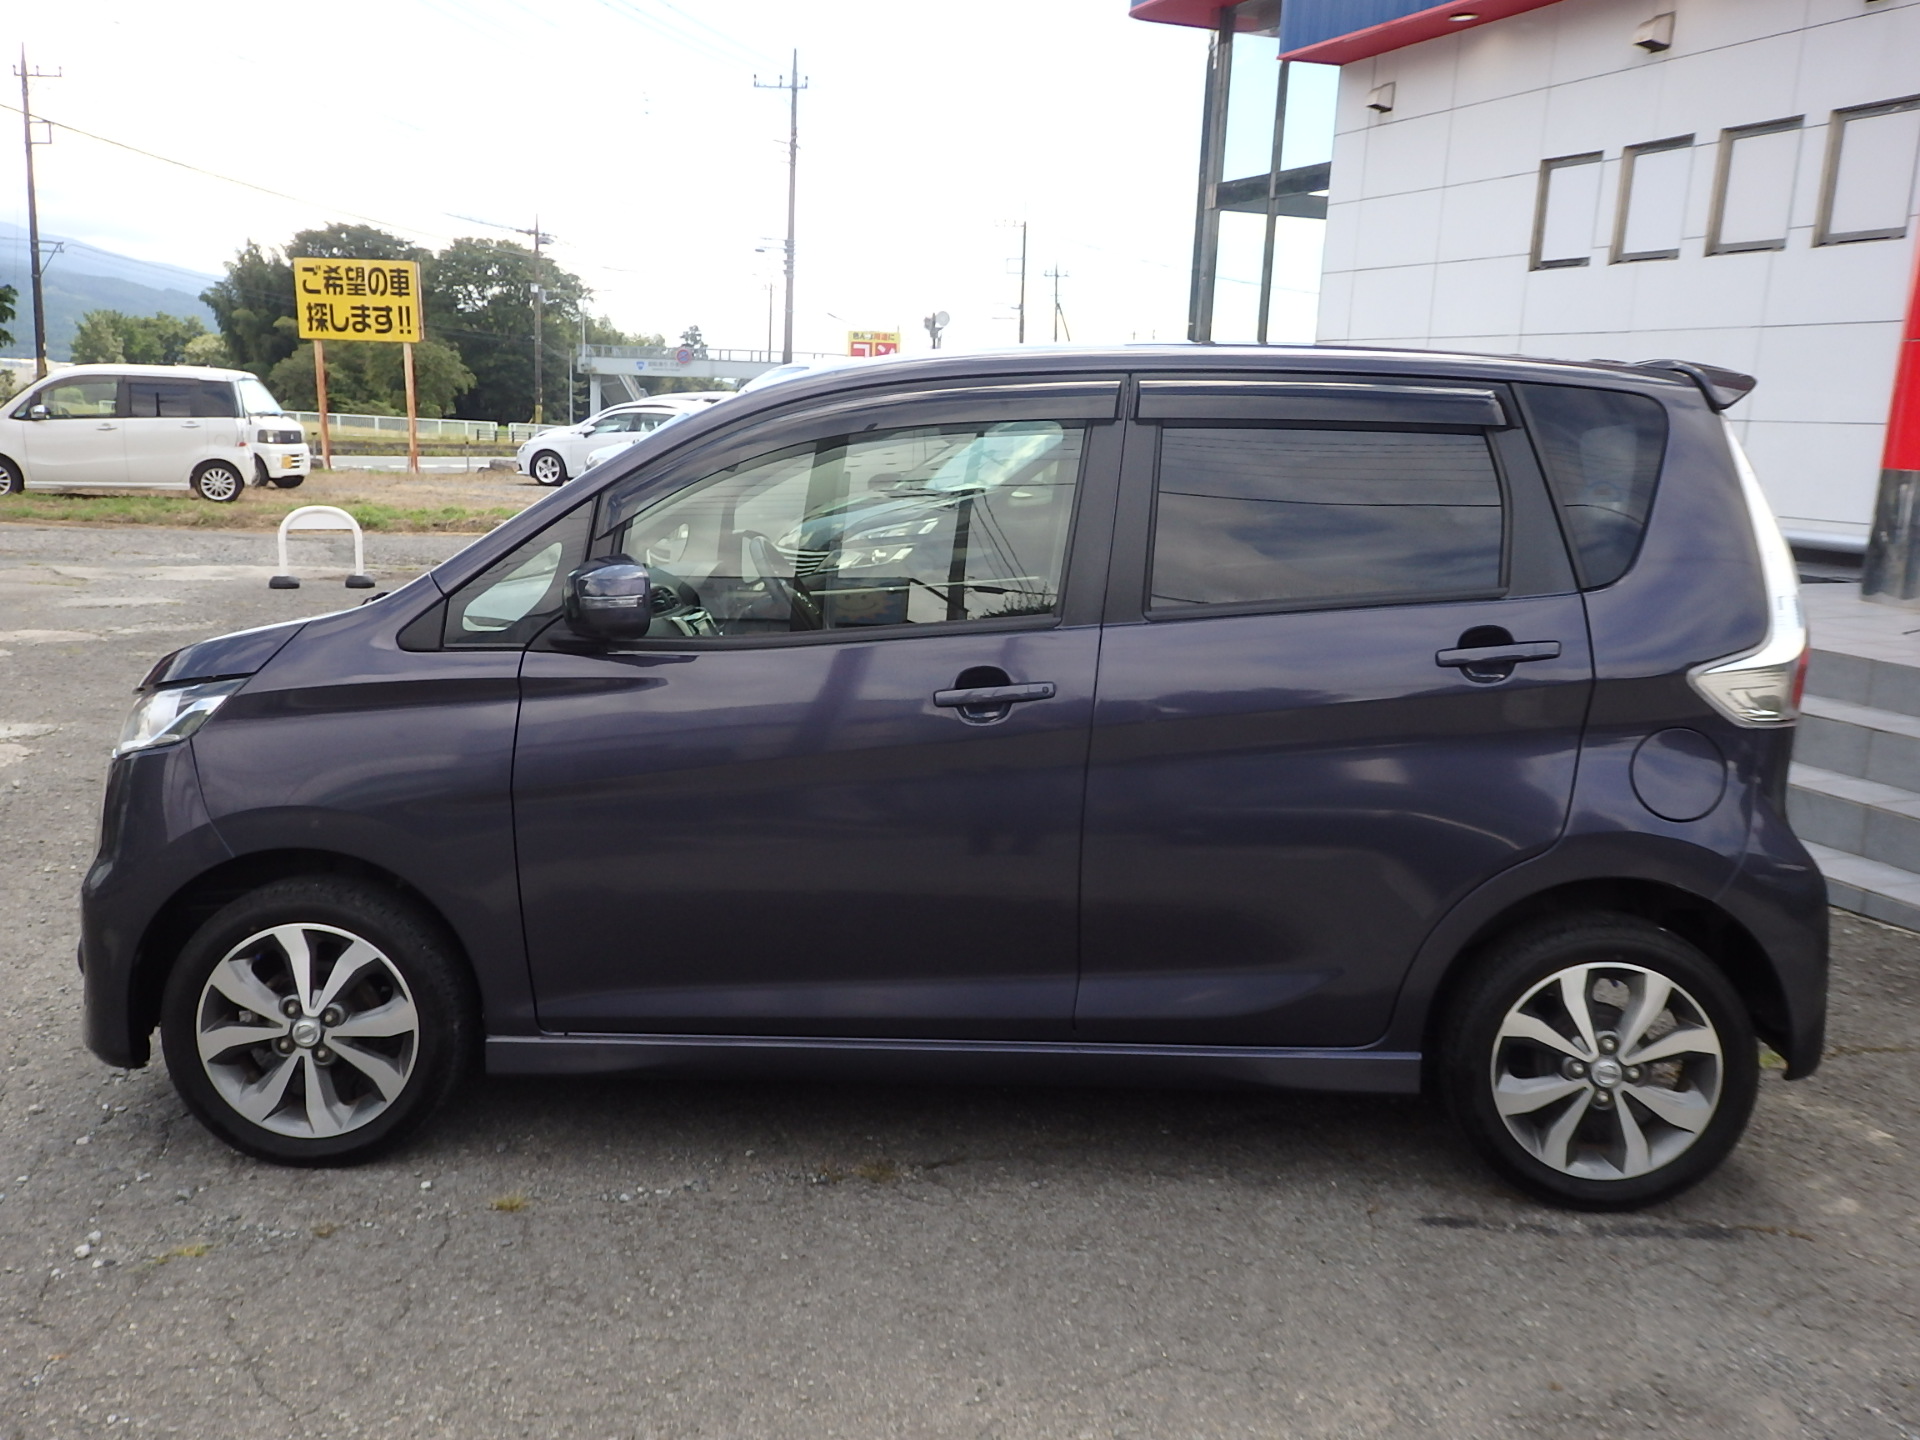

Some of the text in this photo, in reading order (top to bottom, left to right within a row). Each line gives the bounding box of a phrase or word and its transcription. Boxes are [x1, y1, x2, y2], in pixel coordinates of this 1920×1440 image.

[302, 265, 411, 297] ご希望の車
